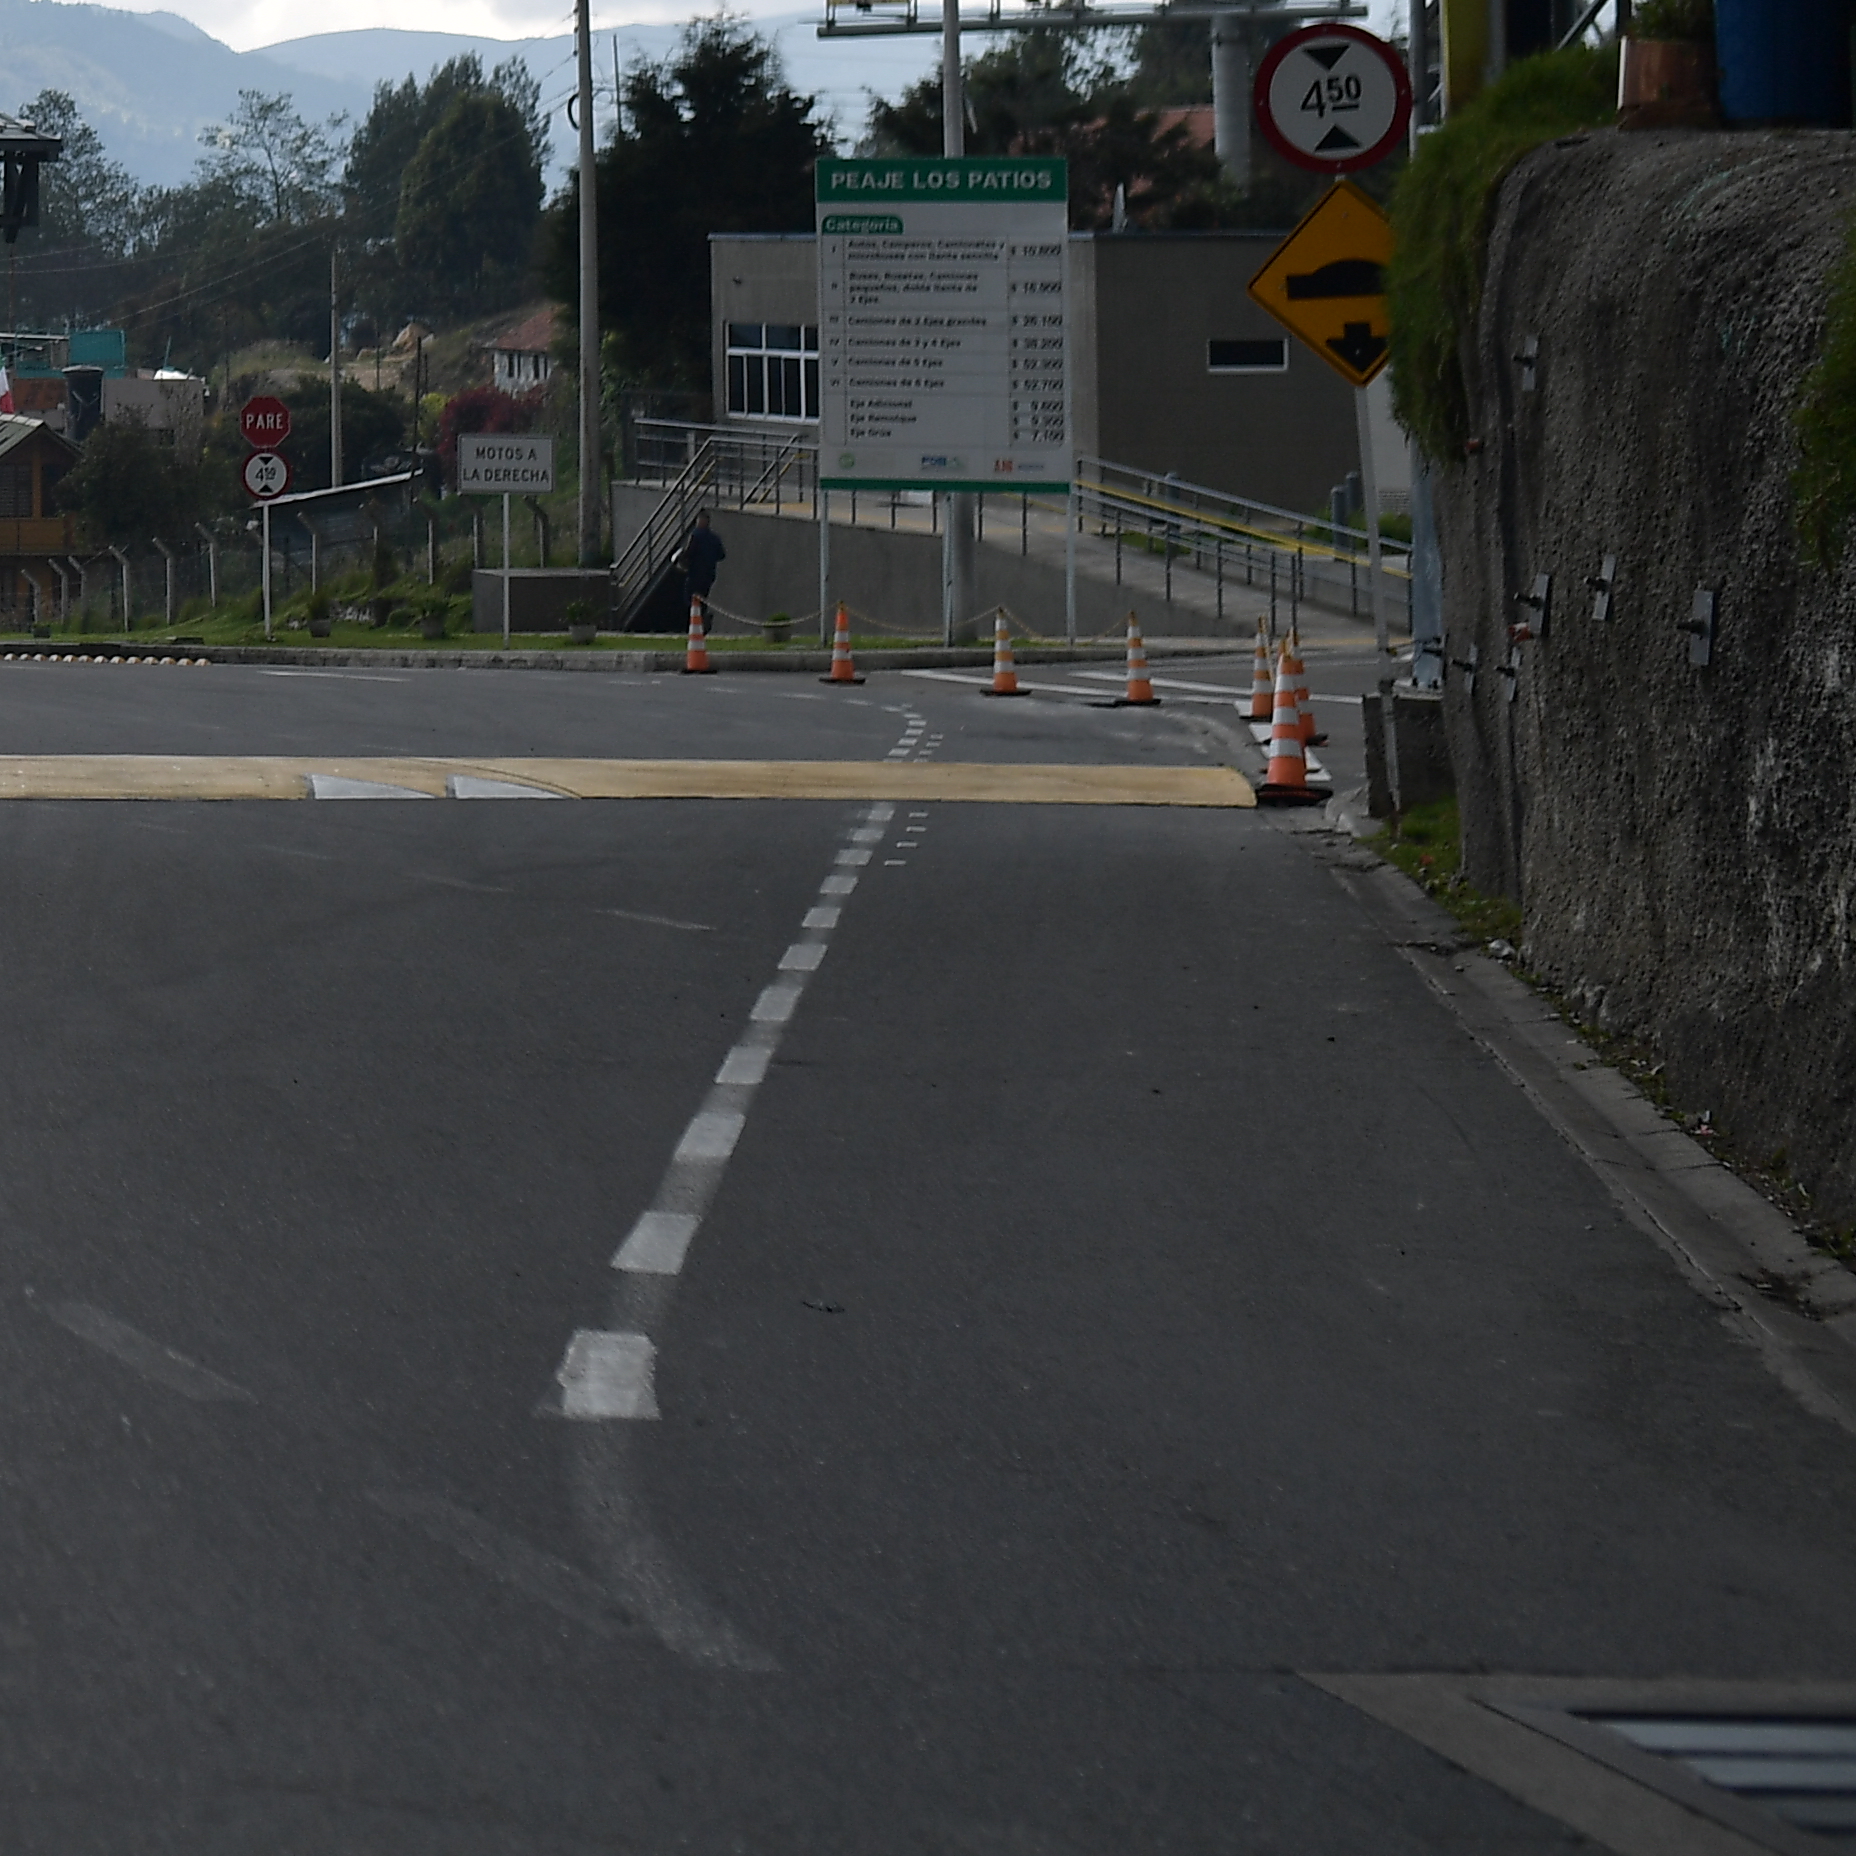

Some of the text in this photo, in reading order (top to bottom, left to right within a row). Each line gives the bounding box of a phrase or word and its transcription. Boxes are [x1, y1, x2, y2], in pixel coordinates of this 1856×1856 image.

[830, 170, 1052, 190] PEAJE LOS PATIOS
[246, 412, 284, 430] PARE
[475, 447, 537, 461] MOTOS A
[462, 468, 550, 483] LA DERECHA
